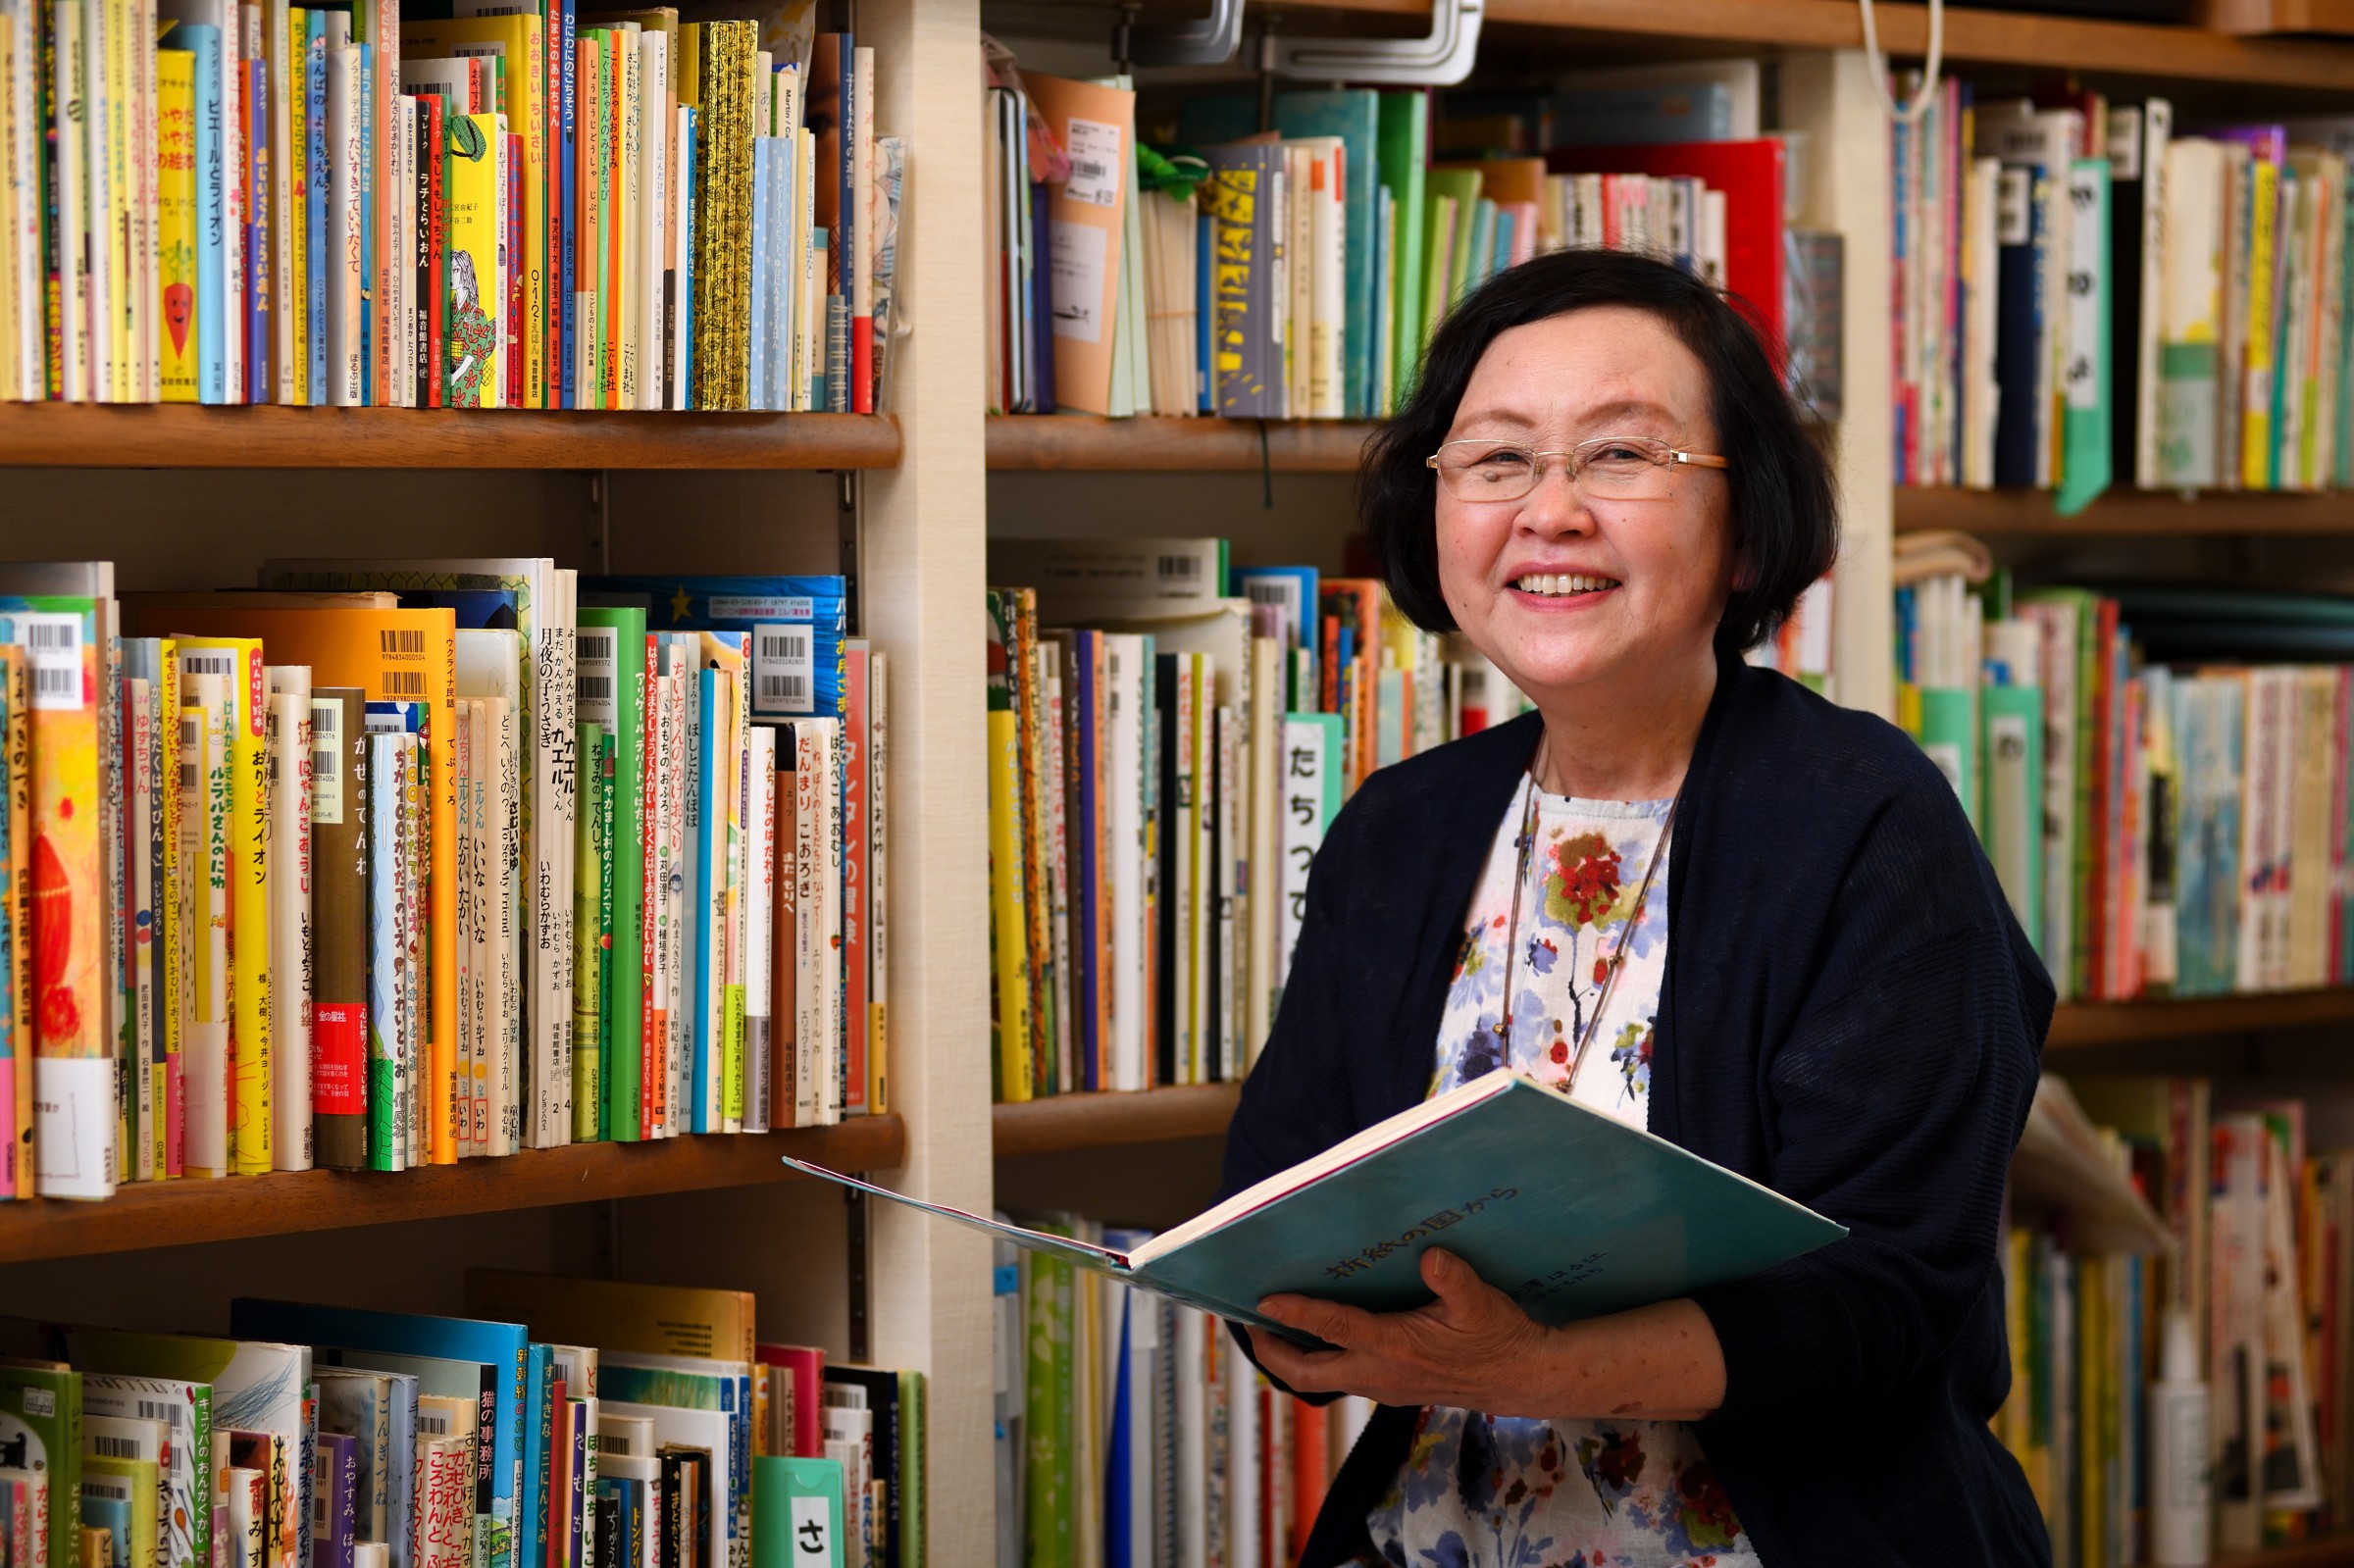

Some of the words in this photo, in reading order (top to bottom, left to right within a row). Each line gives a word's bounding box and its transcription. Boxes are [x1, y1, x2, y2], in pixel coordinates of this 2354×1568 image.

[294, 23, 305, 107] ちょうちょう
[313, 32, 325, 106] ぐるんぱの
[362, 68, 371, 127] おつきさま
[530, 32, 540, 93] おおきい
[549, 9, 560, 127] たまごのあかちゃん
[564, 13, 575, 121] わにわにのごちそう
[294, 114, 305, 172] ひらひら
[421, 114, 430, 149] マレーク
[530, 101, 540, 165] ちいさい
[600, 48, 609, 201] こぐまちゃんのみずあそび
[609, 50, 619, 169] こぐまちゃんおやすみ
[625, 116, 634, 165] さんかく
[207, 99, 222, 246] ピエールとライオン
[313, 115, 325, 188] ようちえん
[362, 132, 371, 192] こんばんは
[347, 137, 360, 273] だいすきっていいたくて
[418, 173, 430, 268] ラチとらいおん
[433, 154, 442, 260] もしゃもしゃちゃん
[419, 309, 428, 363] 福音館書店
[599, 342, 608, 394] こぐま社
[606, 340, 617, 392] こぐま社
[445, 637, 455, 709] ウクライナ民話
[554, 627, 564, 651] まだ
[538, 628, 553, 749] 月夜の子うさぎ
[553, 656, 564, 720] かんがえる
[565, 667, 576, 730] かんがえる
[645, 646, 658, 804] はやくちまちしょうてんがい
[742, 660, 750, 747] いのちをいただく
[136, 713, 150, 795] ゆずちゃん
[150, 685, 164, 843] かもめたくはいびん
[445, 738, 456, 806] てぶくろ
[590, 742, 601, 795] ねずみの
[659, 715, 671, 766] おもちの
[670, 661, 686, 853] ちいちゃんのかげおくり
[686, 722, 699, 829] ほしとたんぽぽ
[797, 736, 811, 812] だんまり
[830, 736, 840, 797] はらぺこ
[209, 767, 226, 889] ルラルさんのにわ
[252, 751, 267, 885] おりとライオン
[659, 773, 670, 813] おふろ
[457, 833, 470, 883] たかい
[473, 835, 486, 887] いいな
[602, 784, 614, 926] やかまし村のクリスマス
[798, 823, 811, 899] こおろぎ
[830, 804, 840, 869] あおむし
[1288, 746, 1316, 965] たちつて
[457, 886, 470, 936] たかい
[473, 894, 486, 944] いいな
[538, 860, 551, 950] いわむらかずお
[643, 809, 656, 966] はやくちはやあるきたいかい
[475, 980, 485, 1022] いわむら
[476, 1024, 486, 1057] かずお
[475, 1107, 486, 1131] いわ
[477, 1391, 495, 1483] 猫の事務所
[540, 1363, 554, 1438] すてきな
[375, 1397, 390, 1507] ごんぎつね
[196, 1462, 210, 1544] おんがくかい
[537, 1451, 553, 1545] 三にんぐみ
[797, 1518, 825, 1554] さ
